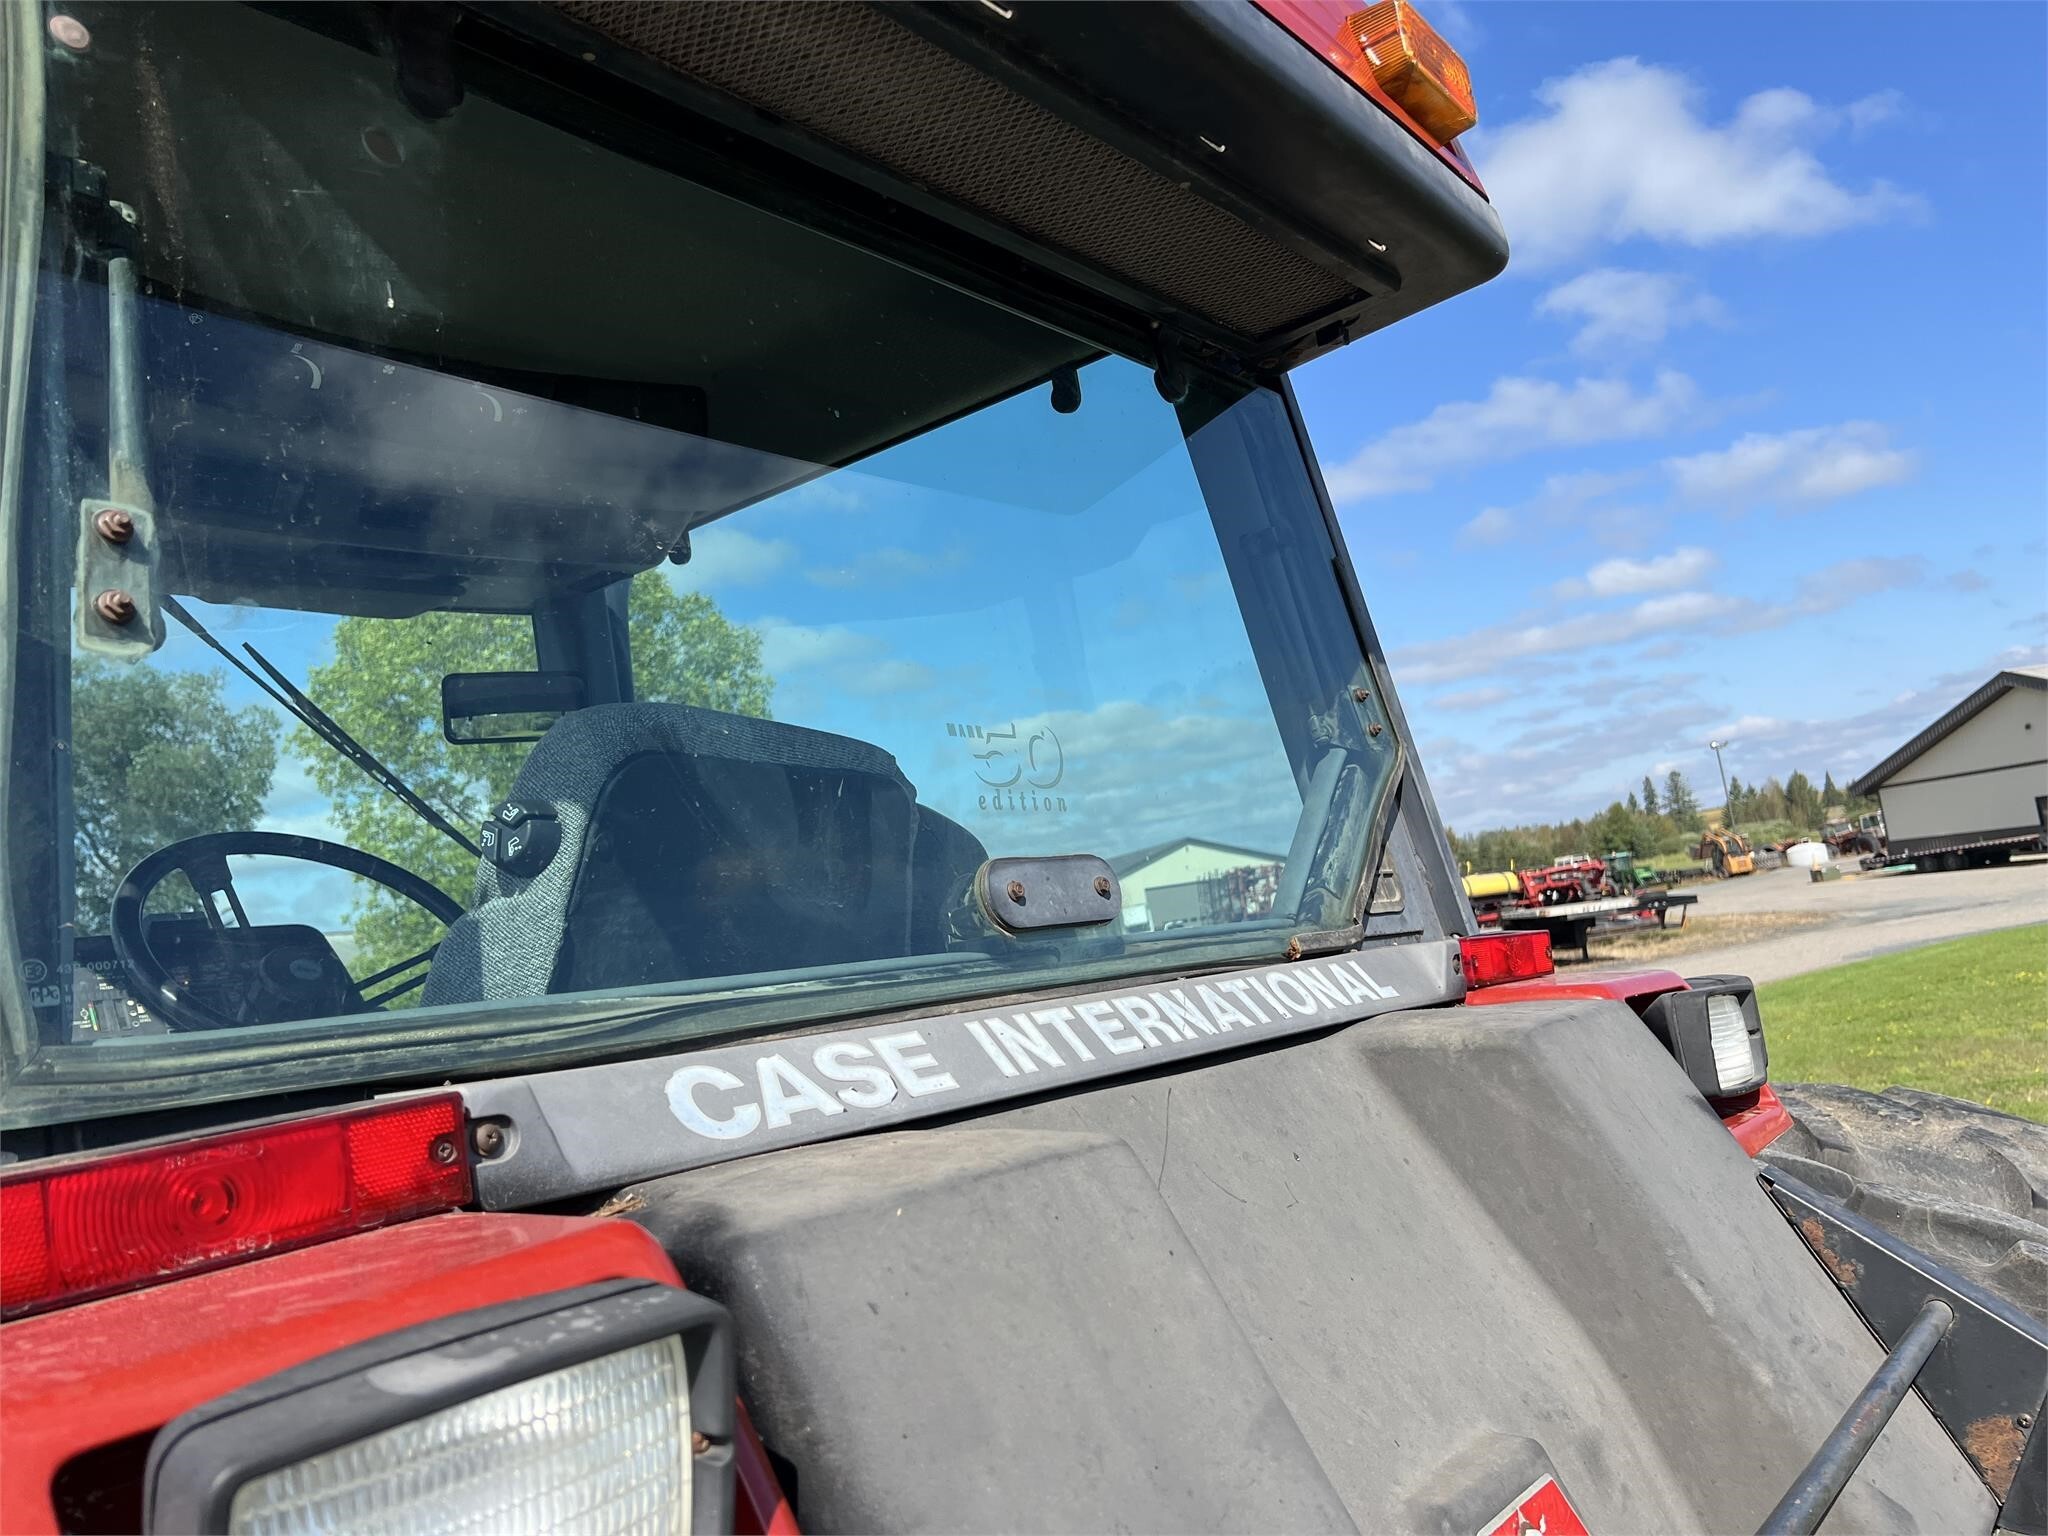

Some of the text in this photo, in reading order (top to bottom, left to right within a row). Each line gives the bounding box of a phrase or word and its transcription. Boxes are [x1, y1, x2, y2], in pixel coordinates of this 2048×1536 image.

[978, 788, 1067, 812] edition
[664, 959, 1401, 1141] CASE INTERNATIONAL
